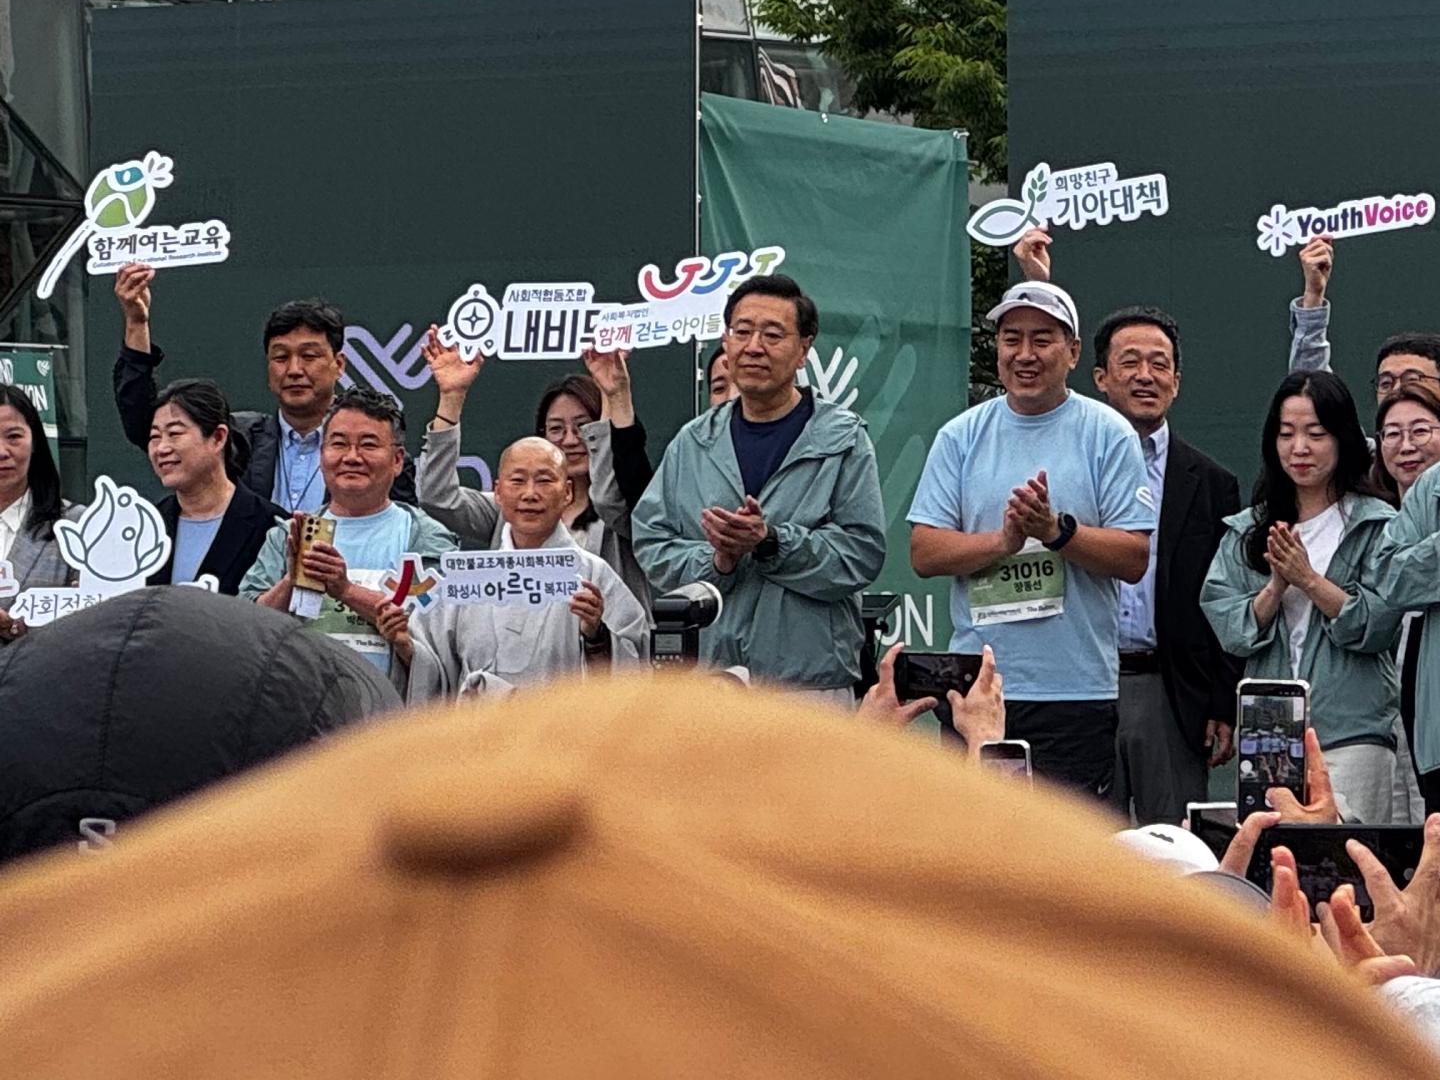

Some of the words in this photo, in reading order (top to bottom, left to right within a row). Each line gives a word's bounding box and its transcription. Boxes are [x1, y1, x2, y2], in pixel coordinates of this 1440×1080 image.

[1055, 168, 1111, 192] 희망친구
[1056, 180, 1162, 224] 기아대책
[1297, 200, 1429, 238] YouthVoice
[93, 226, 223, 261] 함께여는교육
[508, 288, 587, 303] 사회적협동조합
[600, 325, 632, 347] 함께
[636, 322, 668, 342] 걷는
[672, 313, 721, 336] 아이들
[446, 554, 575, 570] 대한불교조계종사회복지재단
[1000, 560, 1054, 581] 31016
[447, 584, 481, 599] 화성시
[484, 572, 542, 604] 아르딤
[544, 581, 578, 596] 복지관
